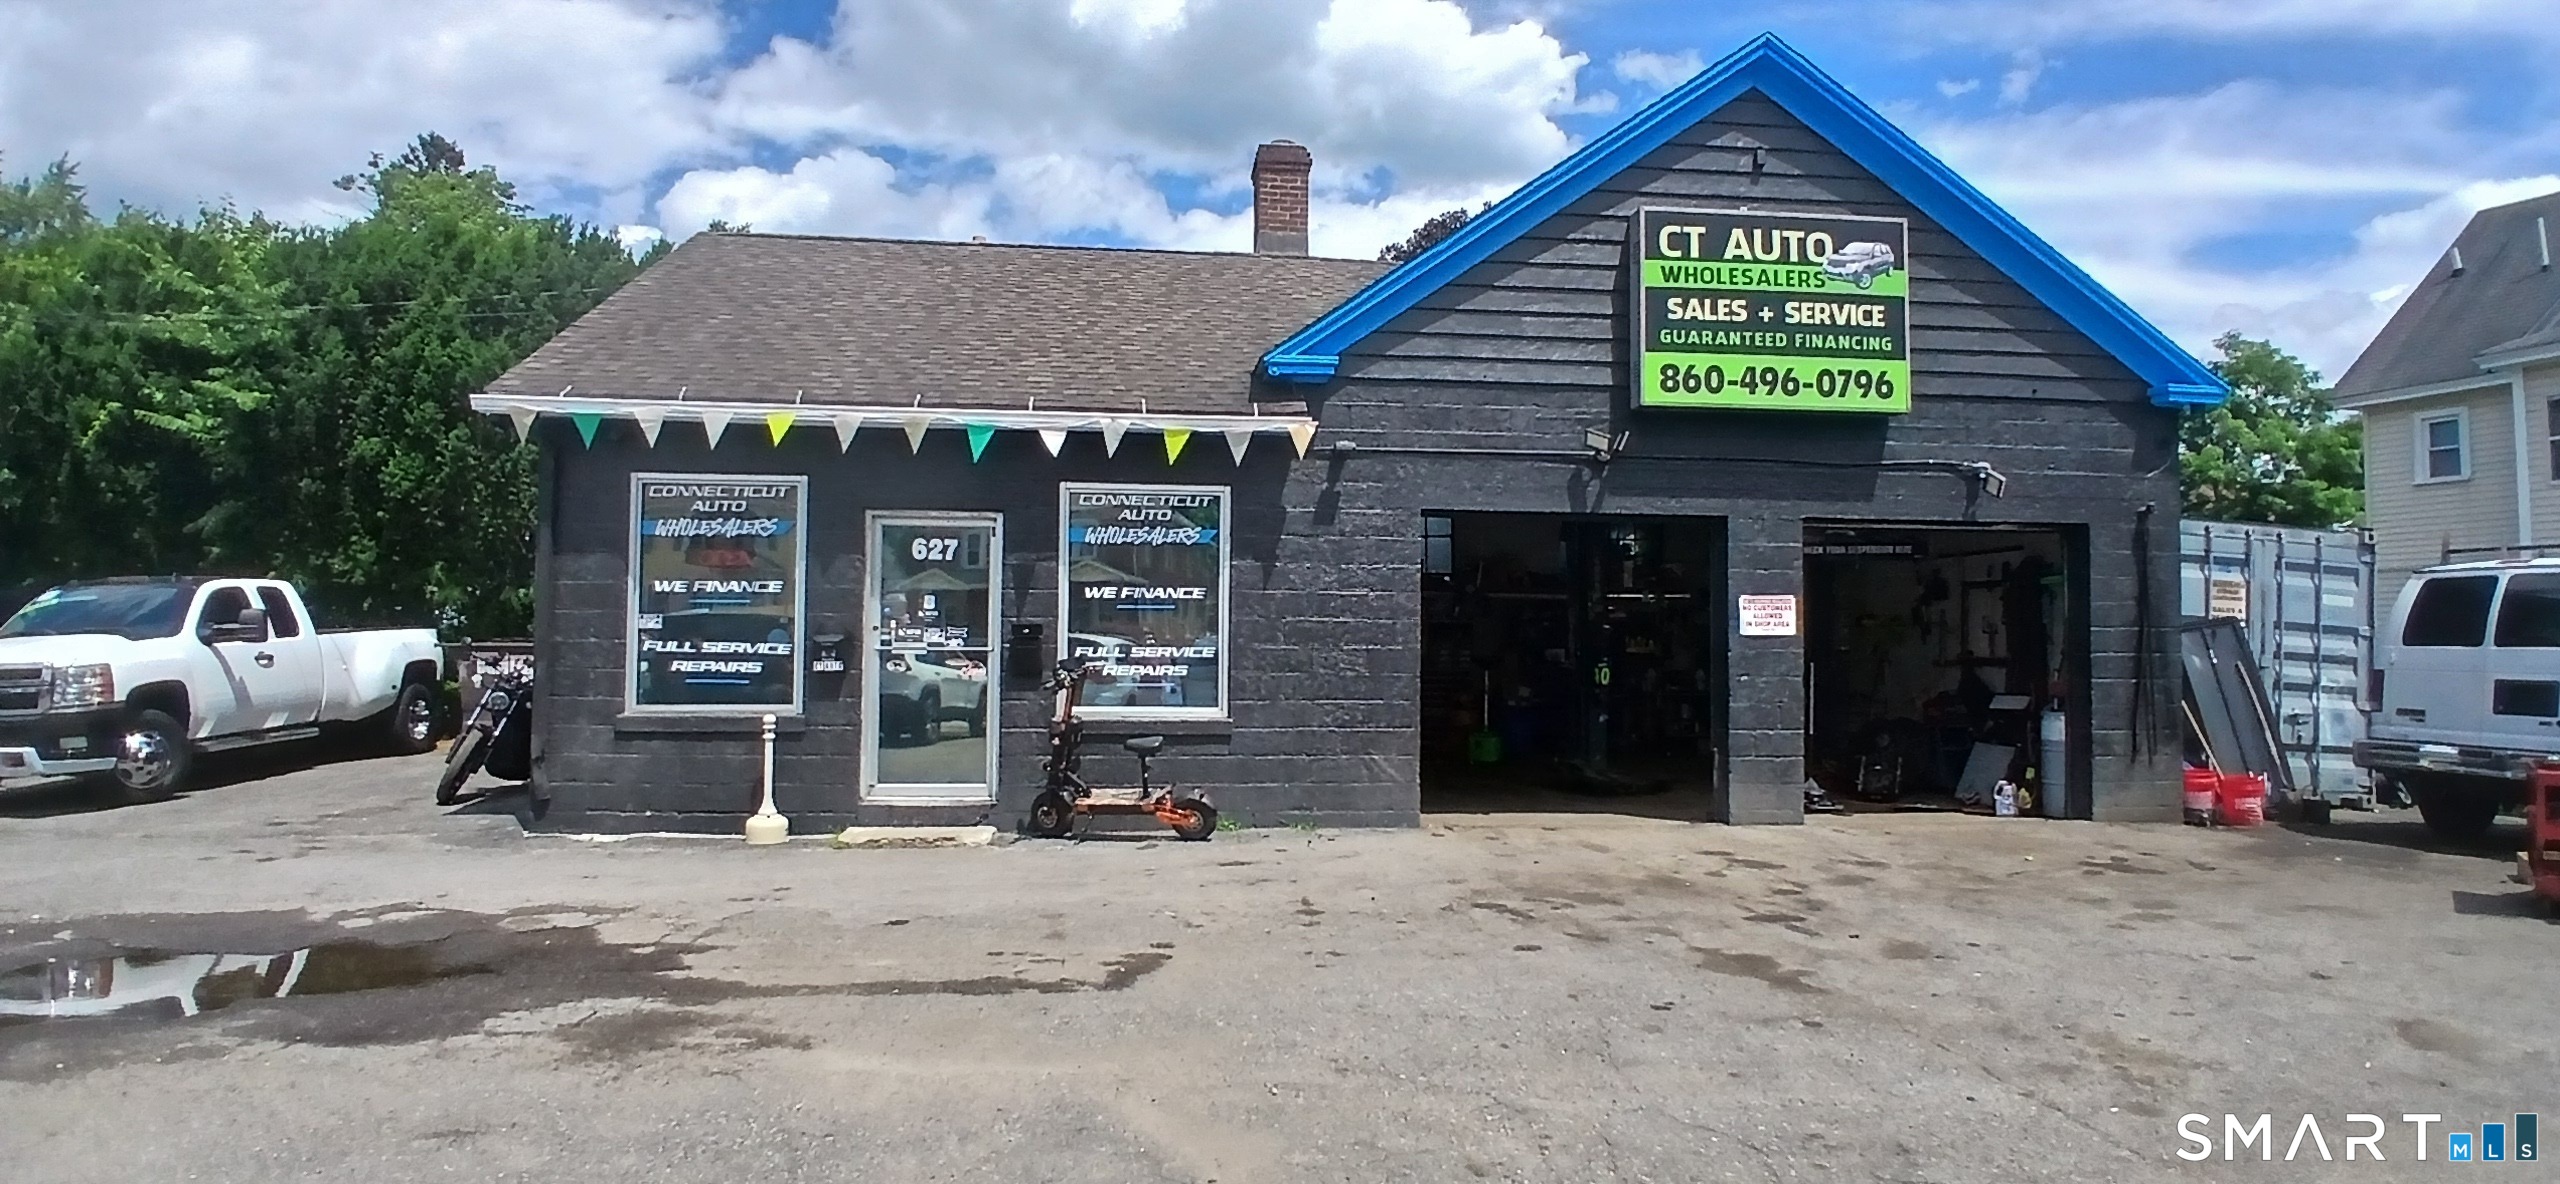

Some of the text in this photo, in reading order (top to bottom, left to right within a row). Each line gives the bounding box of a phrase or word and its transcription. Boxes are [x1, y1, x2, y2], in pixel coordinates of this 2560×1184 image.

[1659, 225, 1834, 263] CT AUTO
[1660, 265, 1827, 289] WHOLESALERS
[1667, 297, 1886, 328] SALES + SERVICE
[1660, 329, 1892, 352] GUARANTEED FINANCING
[1659, 363, 1894, 400] 860-496-0796
[649, 485, 791, 498] CONNECTICUT
[691, 500, 747, 512] AUTO
[1079, 494, 1214, 507] CONNECTICUT
[1118, 509, 1172, 521] AUTO
[654, 517, 779, 538] WHOLESALERS
[1085, 525, 1202, 546] WHOLESALERS
[912, 537, 959, 561] 627
[653, 580, 785, 593] WE FINANCE
[1084, 587, 1207, 599] WE FINANCE
[643, 640, 793, 655] FULL SERVICE
[1075, 646, 1216, 658] FULL SERVICE
[670, 660, 764, 673] REPAIRS
[1102, 664, 1189, 676] REPAIRS
